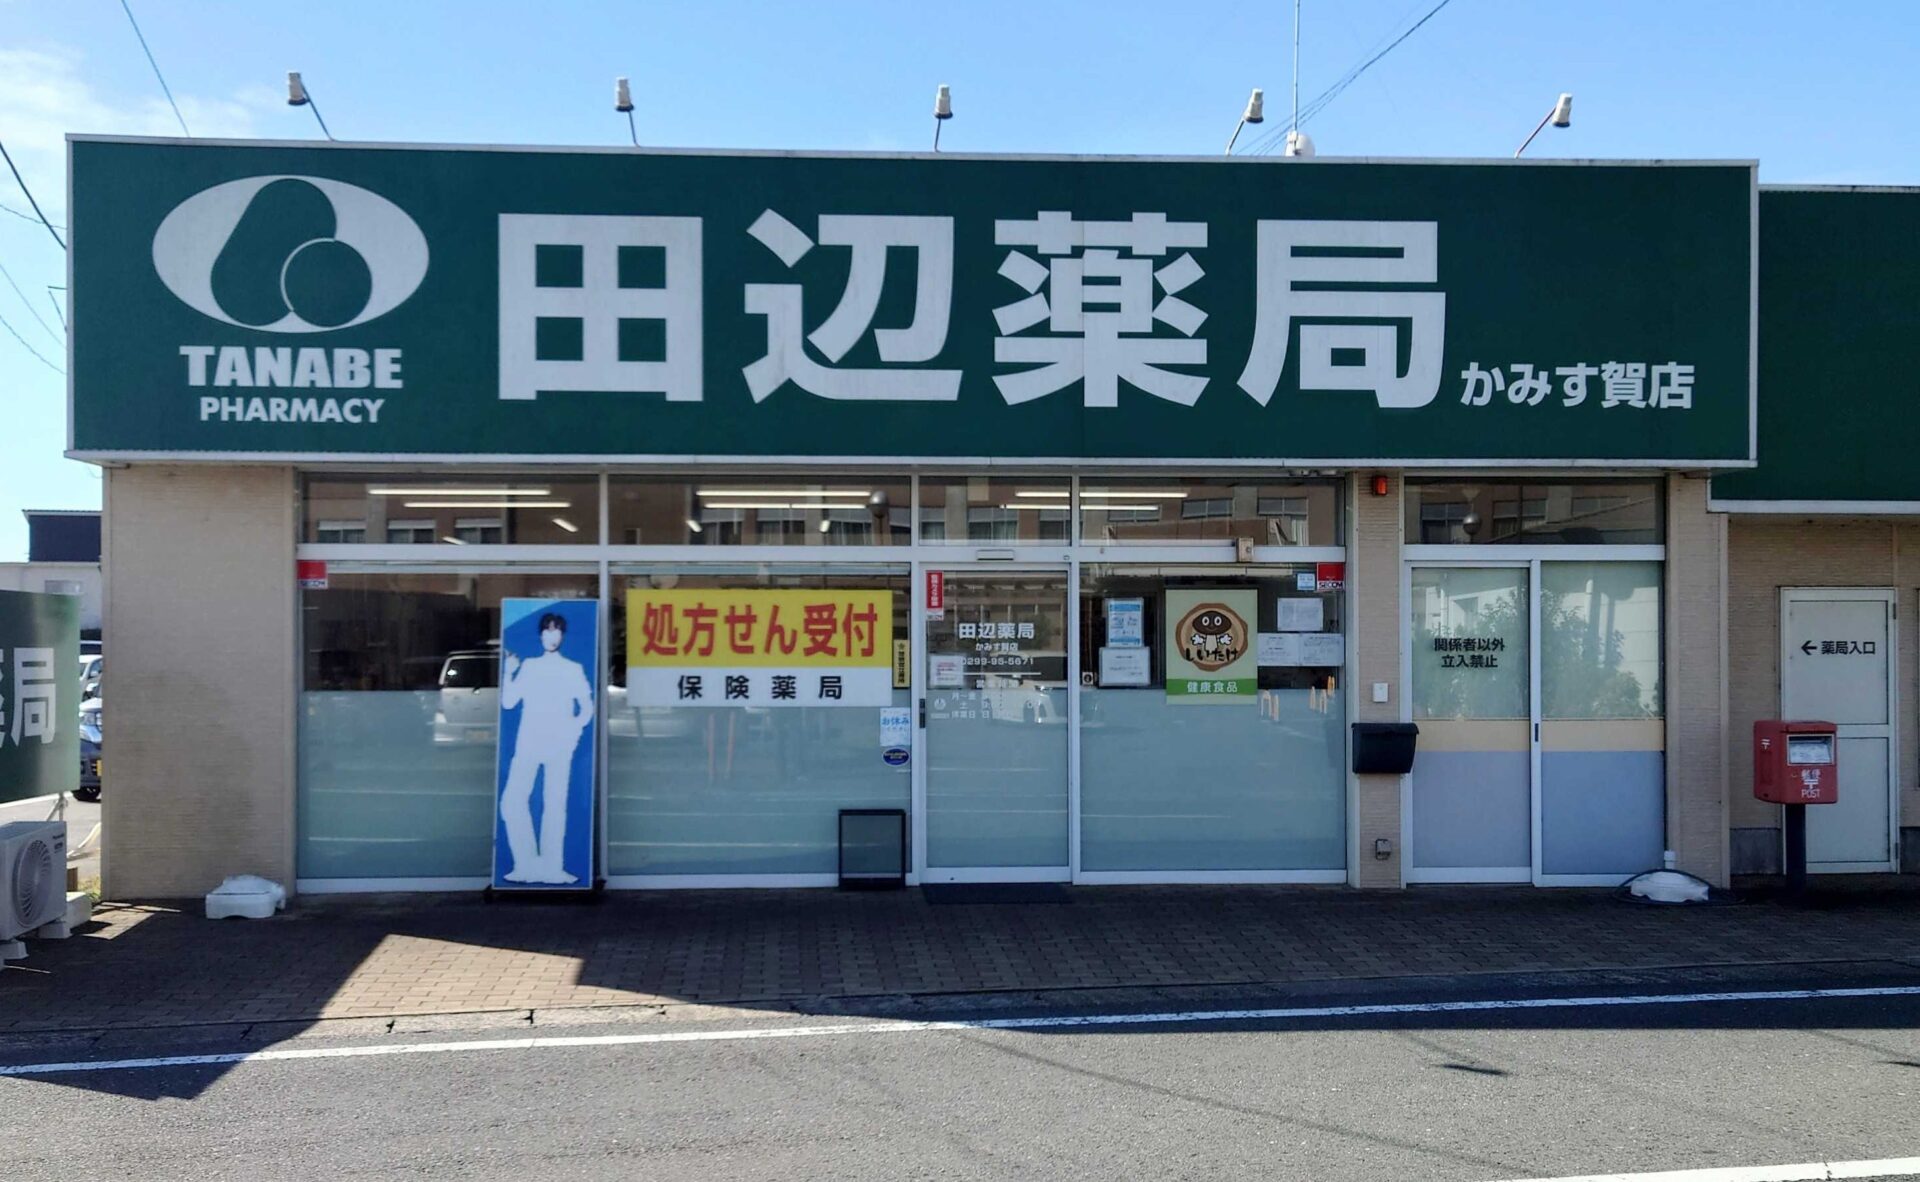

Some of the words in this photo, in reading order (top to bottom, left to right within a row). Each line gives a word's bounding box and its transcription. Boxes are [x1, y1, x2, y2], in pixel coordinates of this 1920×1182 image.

[498, 208, 1447, 408] 田辺薬局
[179, 345, 404, 389] TANABE
[1459, 360, 1696, 409] かみす賀店
[199, 396, 386, 424] PHARMACY
[641, 601, 878, 657] 処方せん受付
[958, 622, 1035, 639] 田辺薬局
[1184, 647, 1239, 662] しいたけ
[1434, 637, 1506, 652] 関係者以外
[1821, 640, 1876, 655] 薬局入口
[1440, 653, 1499, 668] 立入禁止
[677, 674, 843, 700] 保険薬局
[1187, 681, 1238, 693] 健康食品
[0, 648, 57, 748] 局
[1801, 788, 1821, 799] POST
